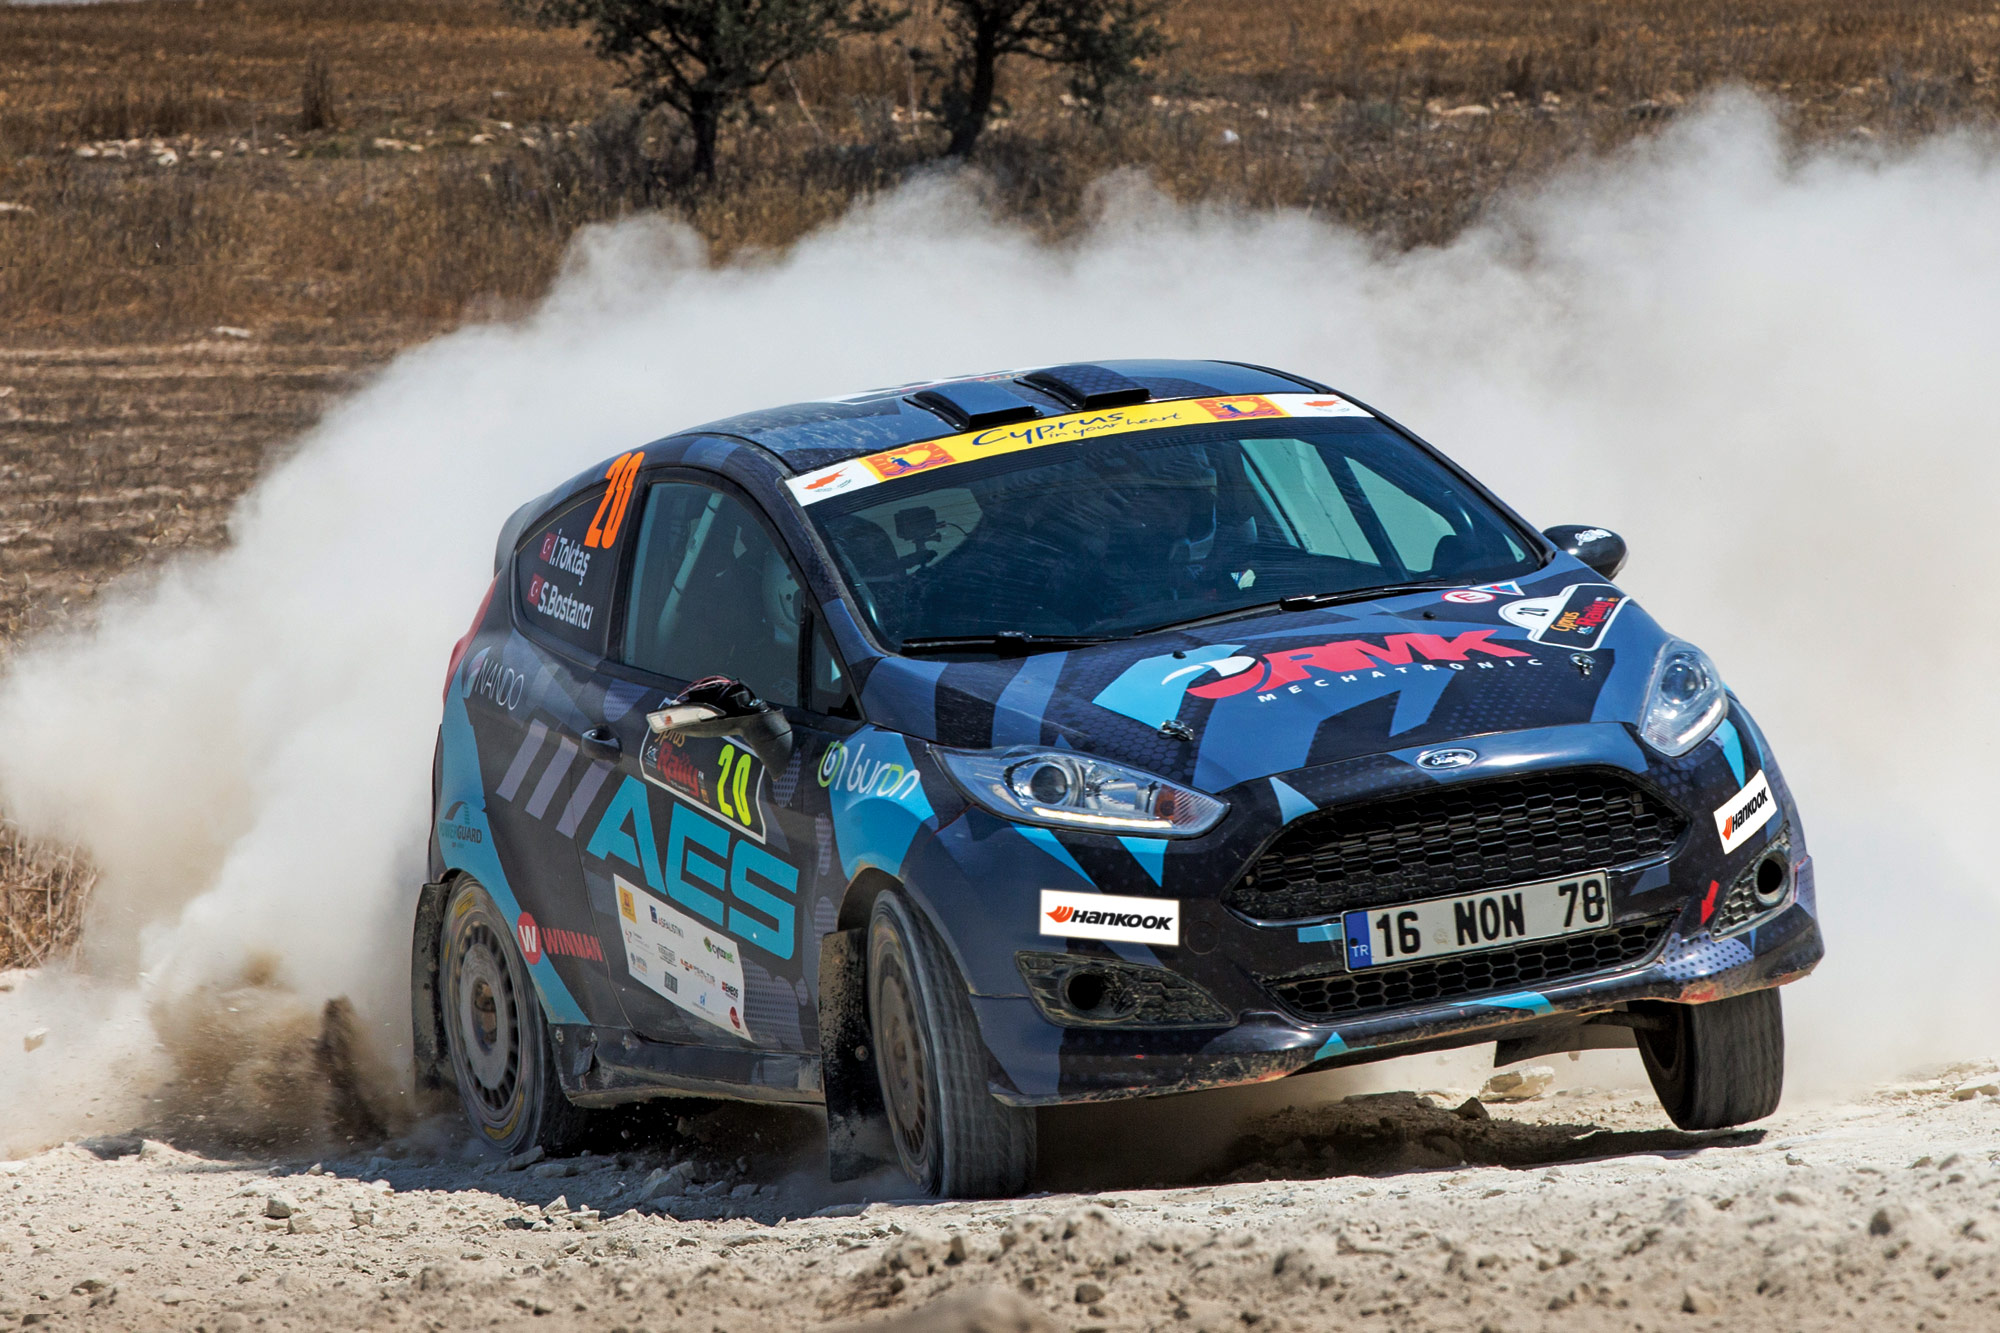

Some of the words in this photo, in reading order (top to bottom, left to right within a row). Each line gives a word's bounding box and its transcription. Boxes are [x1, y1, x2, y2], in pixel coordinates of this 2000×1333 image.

[972, 412, 1125, 446] Cyprus
[1049, 431, 1069, 439] in
[1073, 422, 1116, 438] your
[1126, 412, 1183, 426] heart
[584, 451, 645, 549] 20
[1517, 607, 1549, 617] 20
[1257, 658, 1544, 703] MECHATRONIC
[657, 741, 699, 798] Rally
[1428, 751, 1474, 766] Ford
[717, 743, 752, 827] 20
[586, 774, 799, 961] AES
[1350, 944, 1369, 958] TR
[1375, 911, 1421, 957] 16
[1453, 892, 1526, 946] NON
[1557, 878, 1606, 927] 78
[518, 925, 537, 953] W
[541, 927, 604, 963] WINMAN
